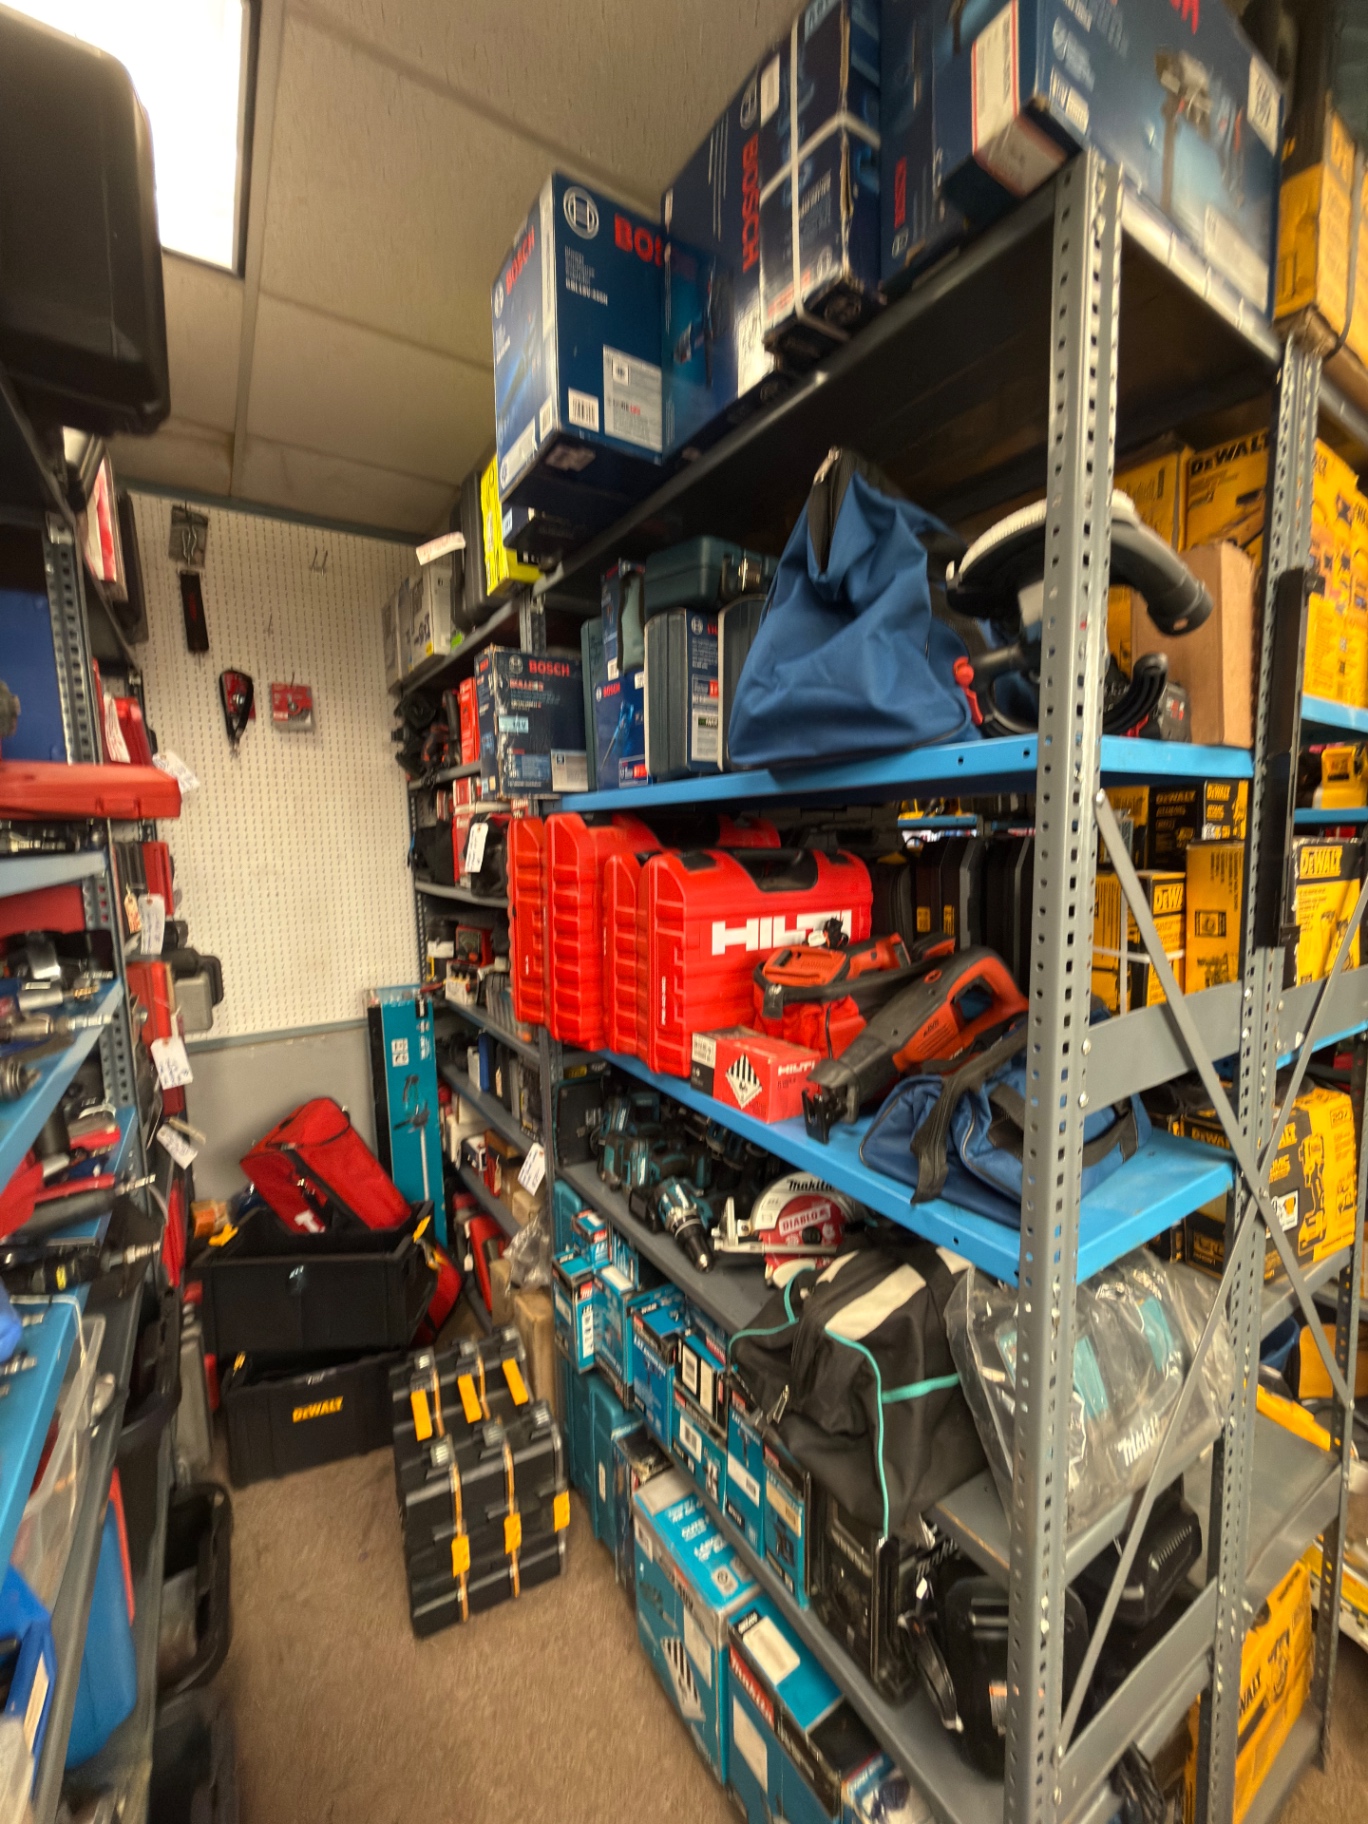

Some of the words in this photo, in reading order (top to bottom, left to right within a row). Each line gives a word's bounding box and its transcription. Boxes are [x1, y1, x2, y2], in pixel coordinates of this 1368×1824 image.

[528, 660, 570, 677] BOSCH
[1300, 846, 1343, 878] DEWALT
[711, 909, 852, 956] HILTI
[778, 1060, 815, 1077] HILTI
[1191, 1127, 1230, 1149] DEWA
[782, 1209, 818, 1232] DIABLO
[292, 1395, 343, 1424] DEWALT
